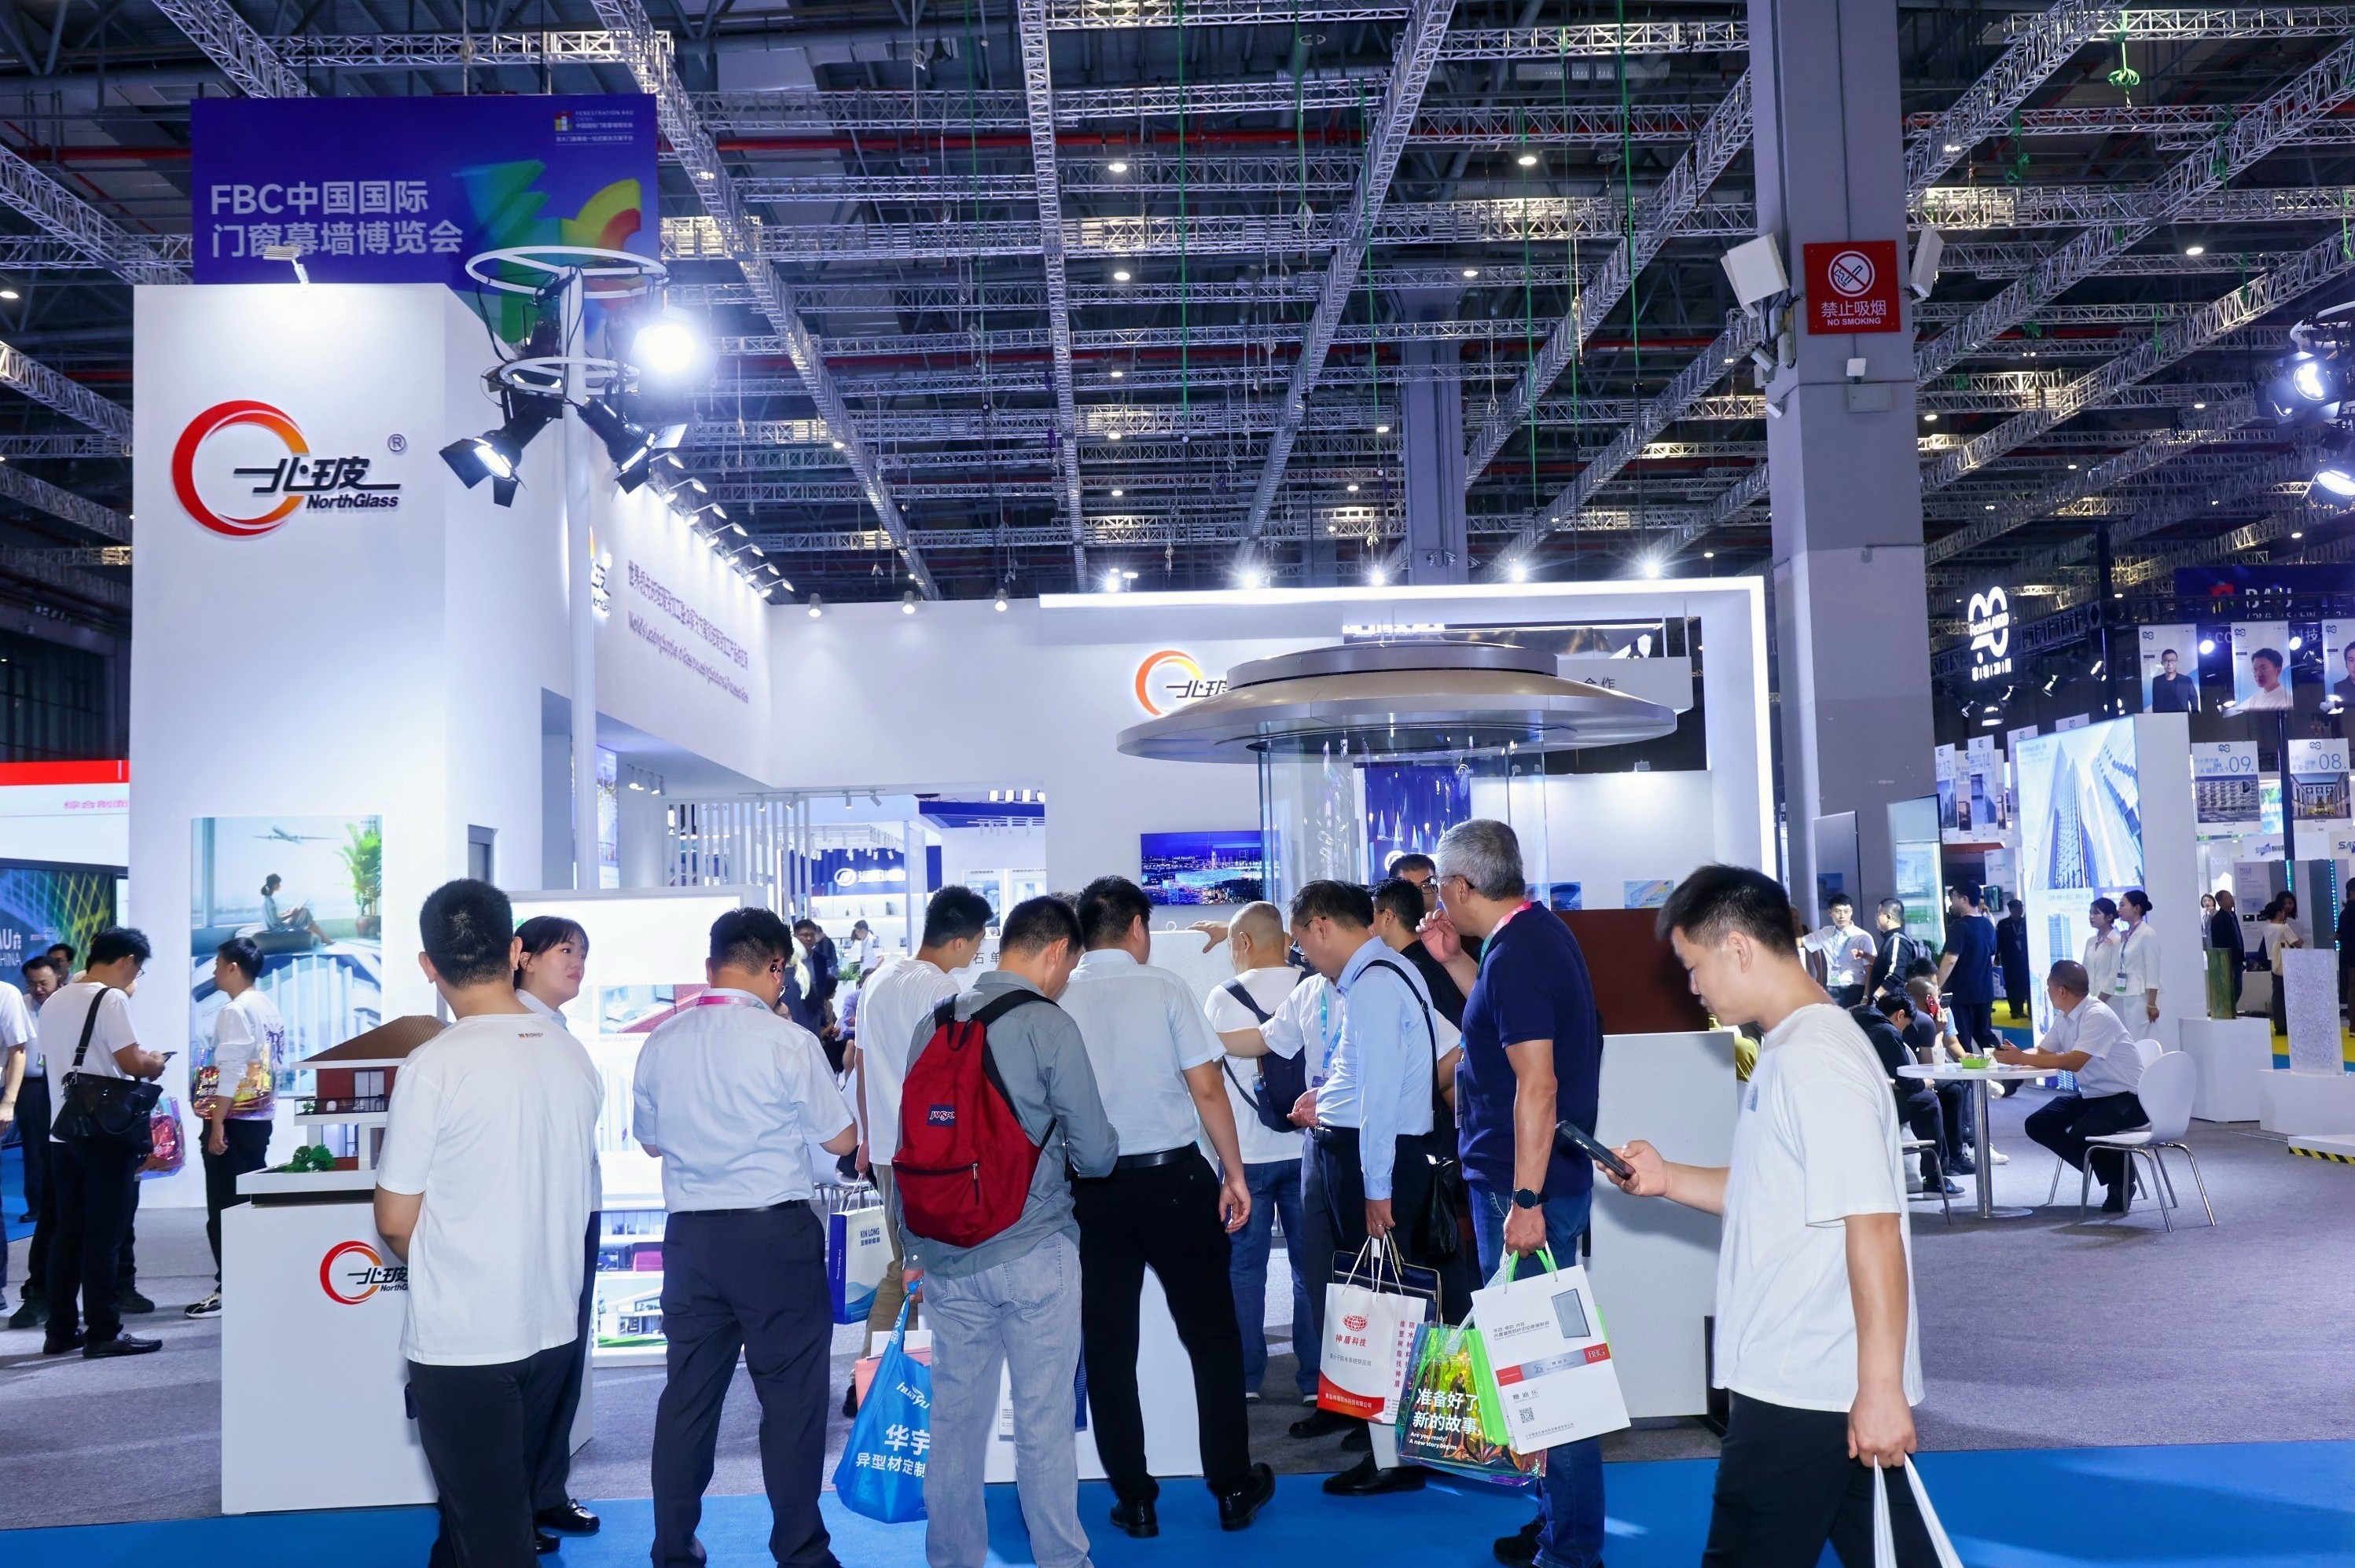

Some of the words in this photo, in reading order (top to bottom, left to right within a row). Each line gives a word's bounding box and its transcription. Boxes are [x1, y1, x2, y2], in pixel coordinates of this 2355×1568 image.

[211, 180, 429, 215] FBC中国国际
[212, 220, 464, 258] 门窗幕墙博览会
[1820, 299, 1887, 318] 禁止吸烟
[1842, 317, 1881, 325] SMOKING
[307, 494, 399, 510] NorthGlass
[869, 1228, 880, 1236] LONG
[1335, 1333, 1367, 1347] 神盾科技
[884, 1423, 931, 1456] 华宇
[855, 1452, 926, 1478] 异型材定制
